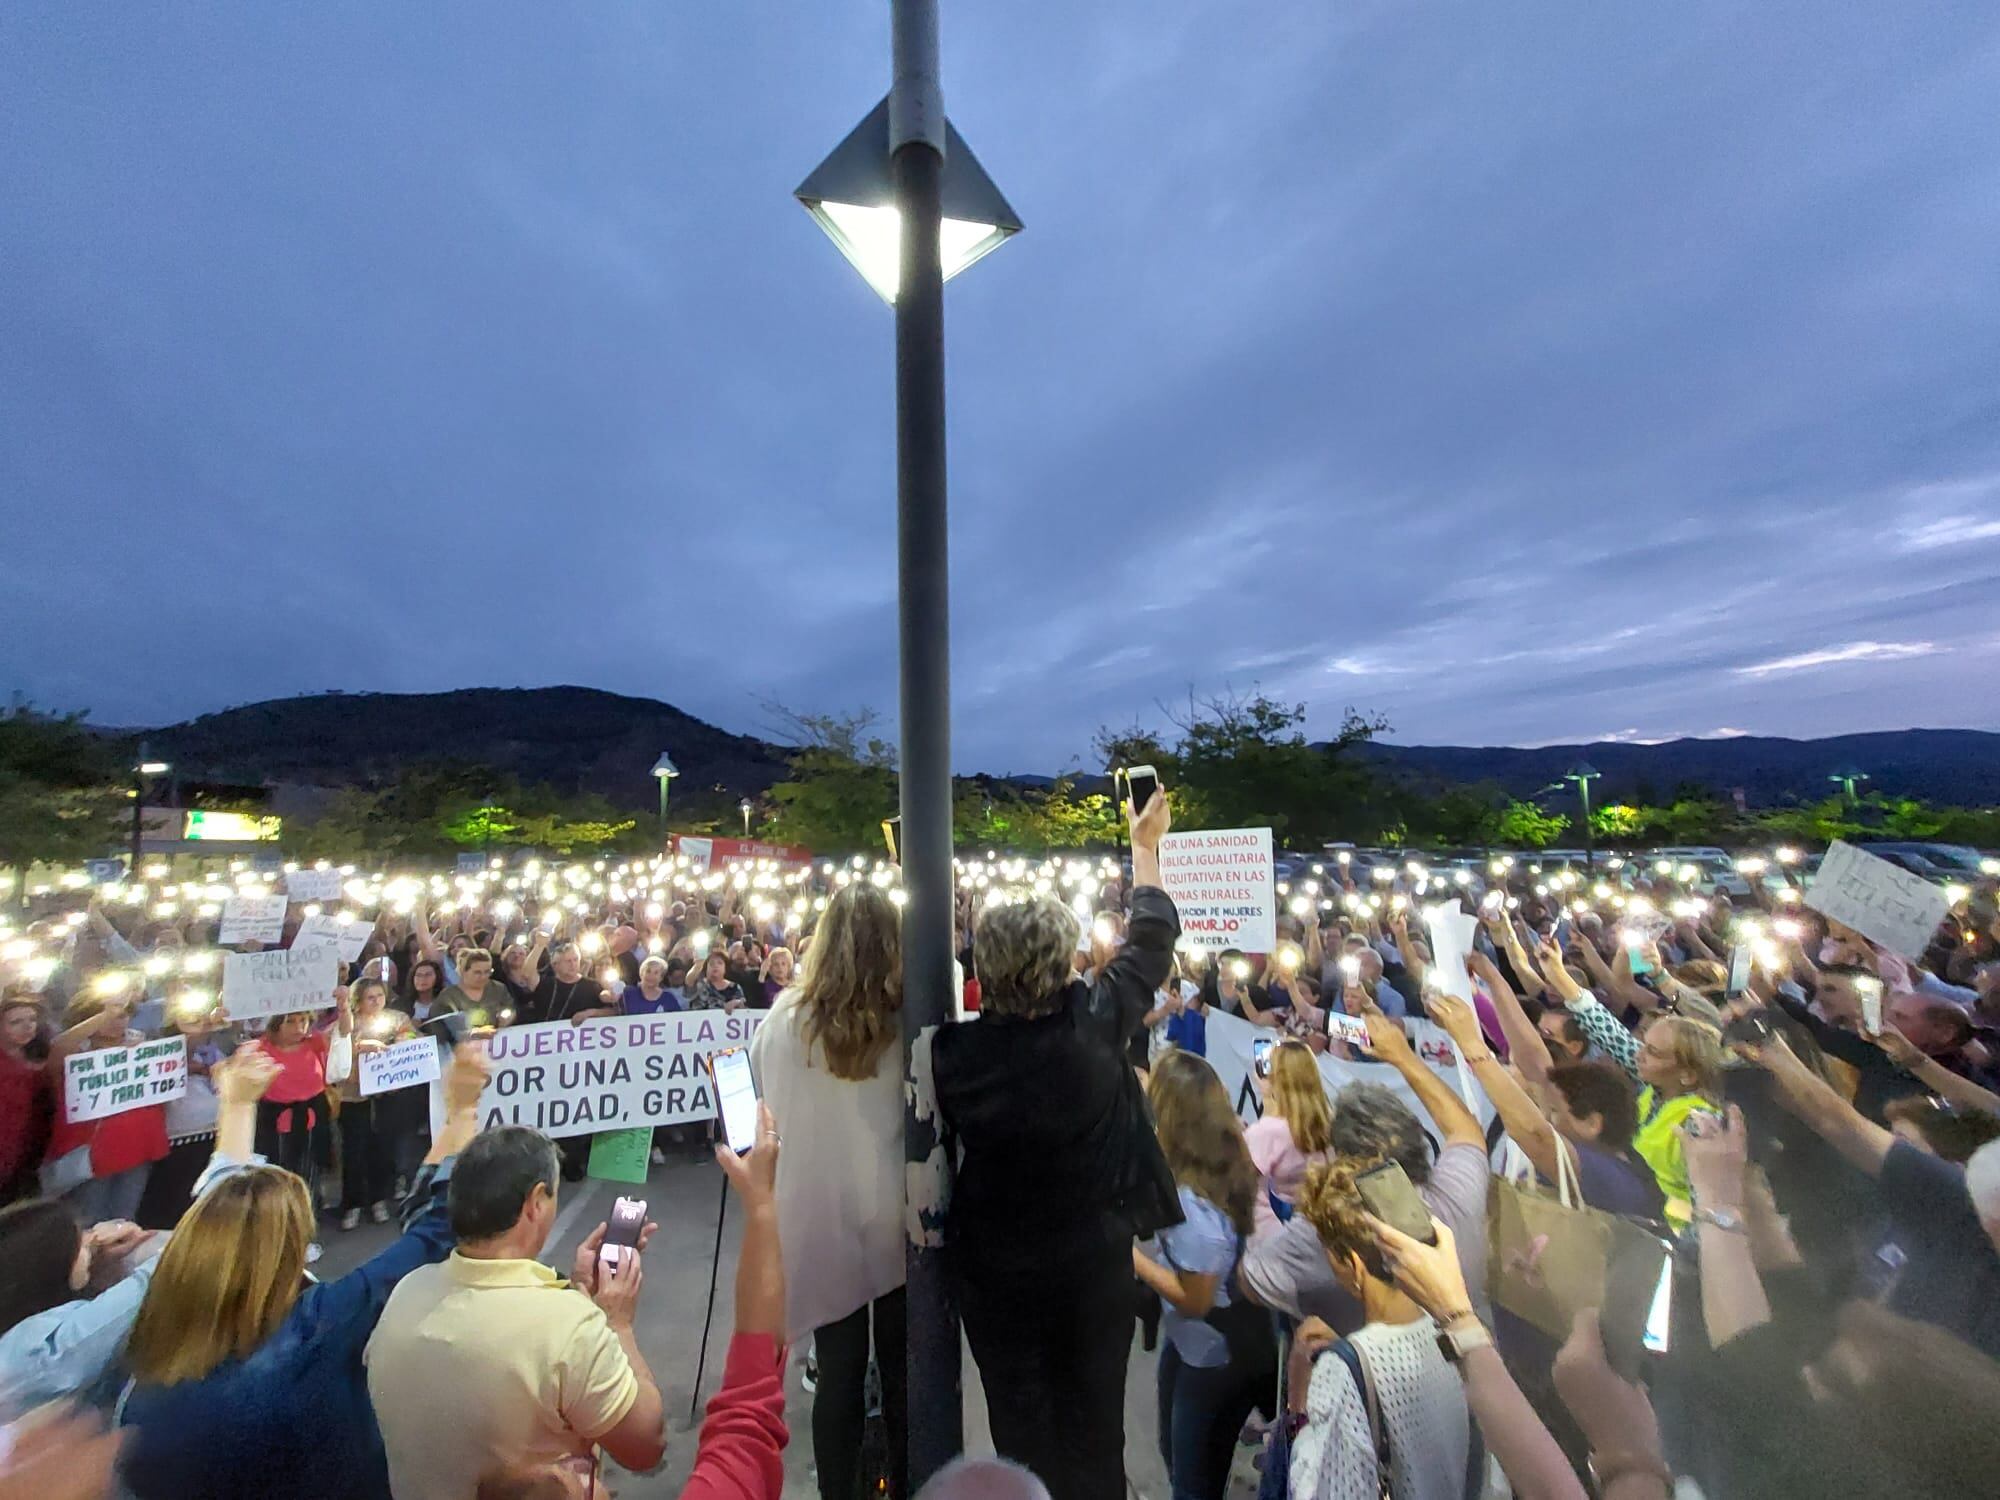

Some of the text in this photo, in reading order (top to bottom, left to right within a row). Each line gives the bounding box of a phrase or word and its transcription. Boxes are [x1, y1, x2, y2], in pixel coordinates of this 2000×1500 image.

[1162, 835, 1258, 850] OR UNA SANIDAD
[1161, 852, 1267, 868] UBLICA IGUALITARIA
[1226, 870, 1240, 881] EN
[1244, 870, 1266, 881] LAS
[1169, 888, 1255, 902] ONAS RURALES.
[1210, 907, 1220, 916] DE
[1223, 906, 1263, 917] MUJERES
[1193, 936, 1231, 945] ORCERA
[487, 1025, 617, 1061] UJERES
[628, 1022, 667, 1047] DE
[677, 1019, 715, 1044] LA
[70, 1039, 183, 1074] POR UNA SANIDAD
[134, 1063, 150, 1080] DE
[377, 1066, 420, 1087] MATAN
[559, 1057, 632, 1089] UNA
[644, 1051, 712, 1082] SAN
[88, 1091, 101, 1111] Y
[111, 1082, 145, 1105] PARA
[484, 1085, 711, 1134] ALIDAD, GRA
